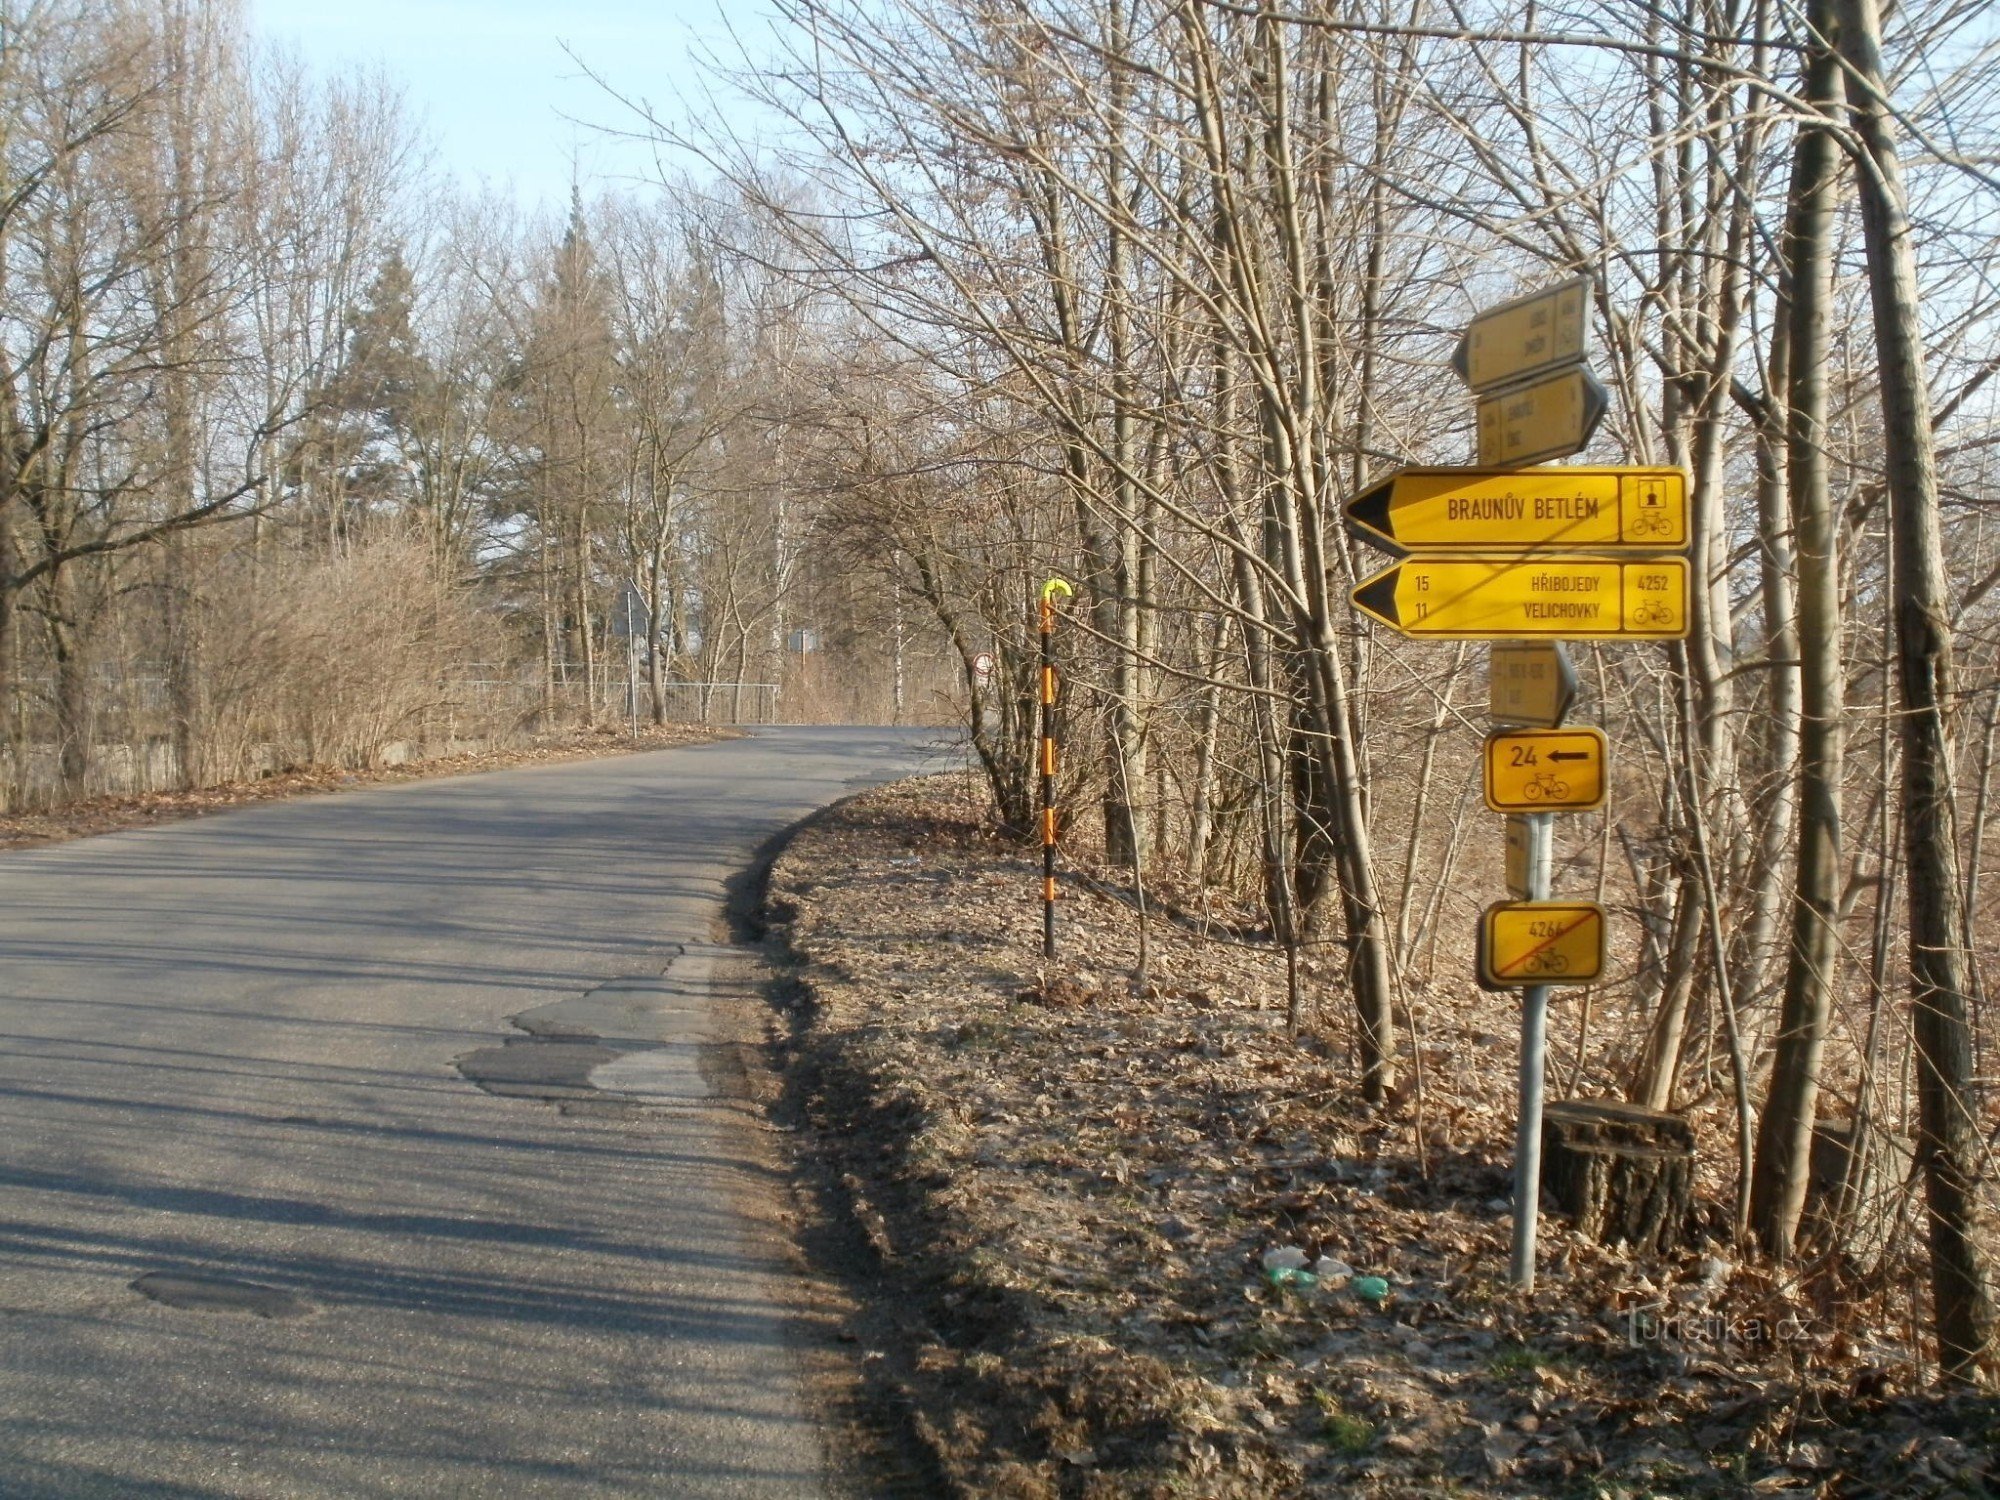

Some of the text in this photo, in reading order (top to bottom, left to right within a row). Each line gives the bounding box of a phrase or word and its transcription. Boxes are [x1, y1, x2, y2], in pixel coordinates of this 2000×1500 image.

[1448, 491, 1599, 520] BRAUNŮV BETLÉM
[1415, 576, 1430, 592] 15
[1531, 573, 1600, 592] HŘIBOJEDY
[1637, 576, 1668, 591] 4252
[1415, 603, 1429, 618] 11
[1524, 603, 1600, 618] VELICHOVKY
[1511, 745, 1538, 767] 24
